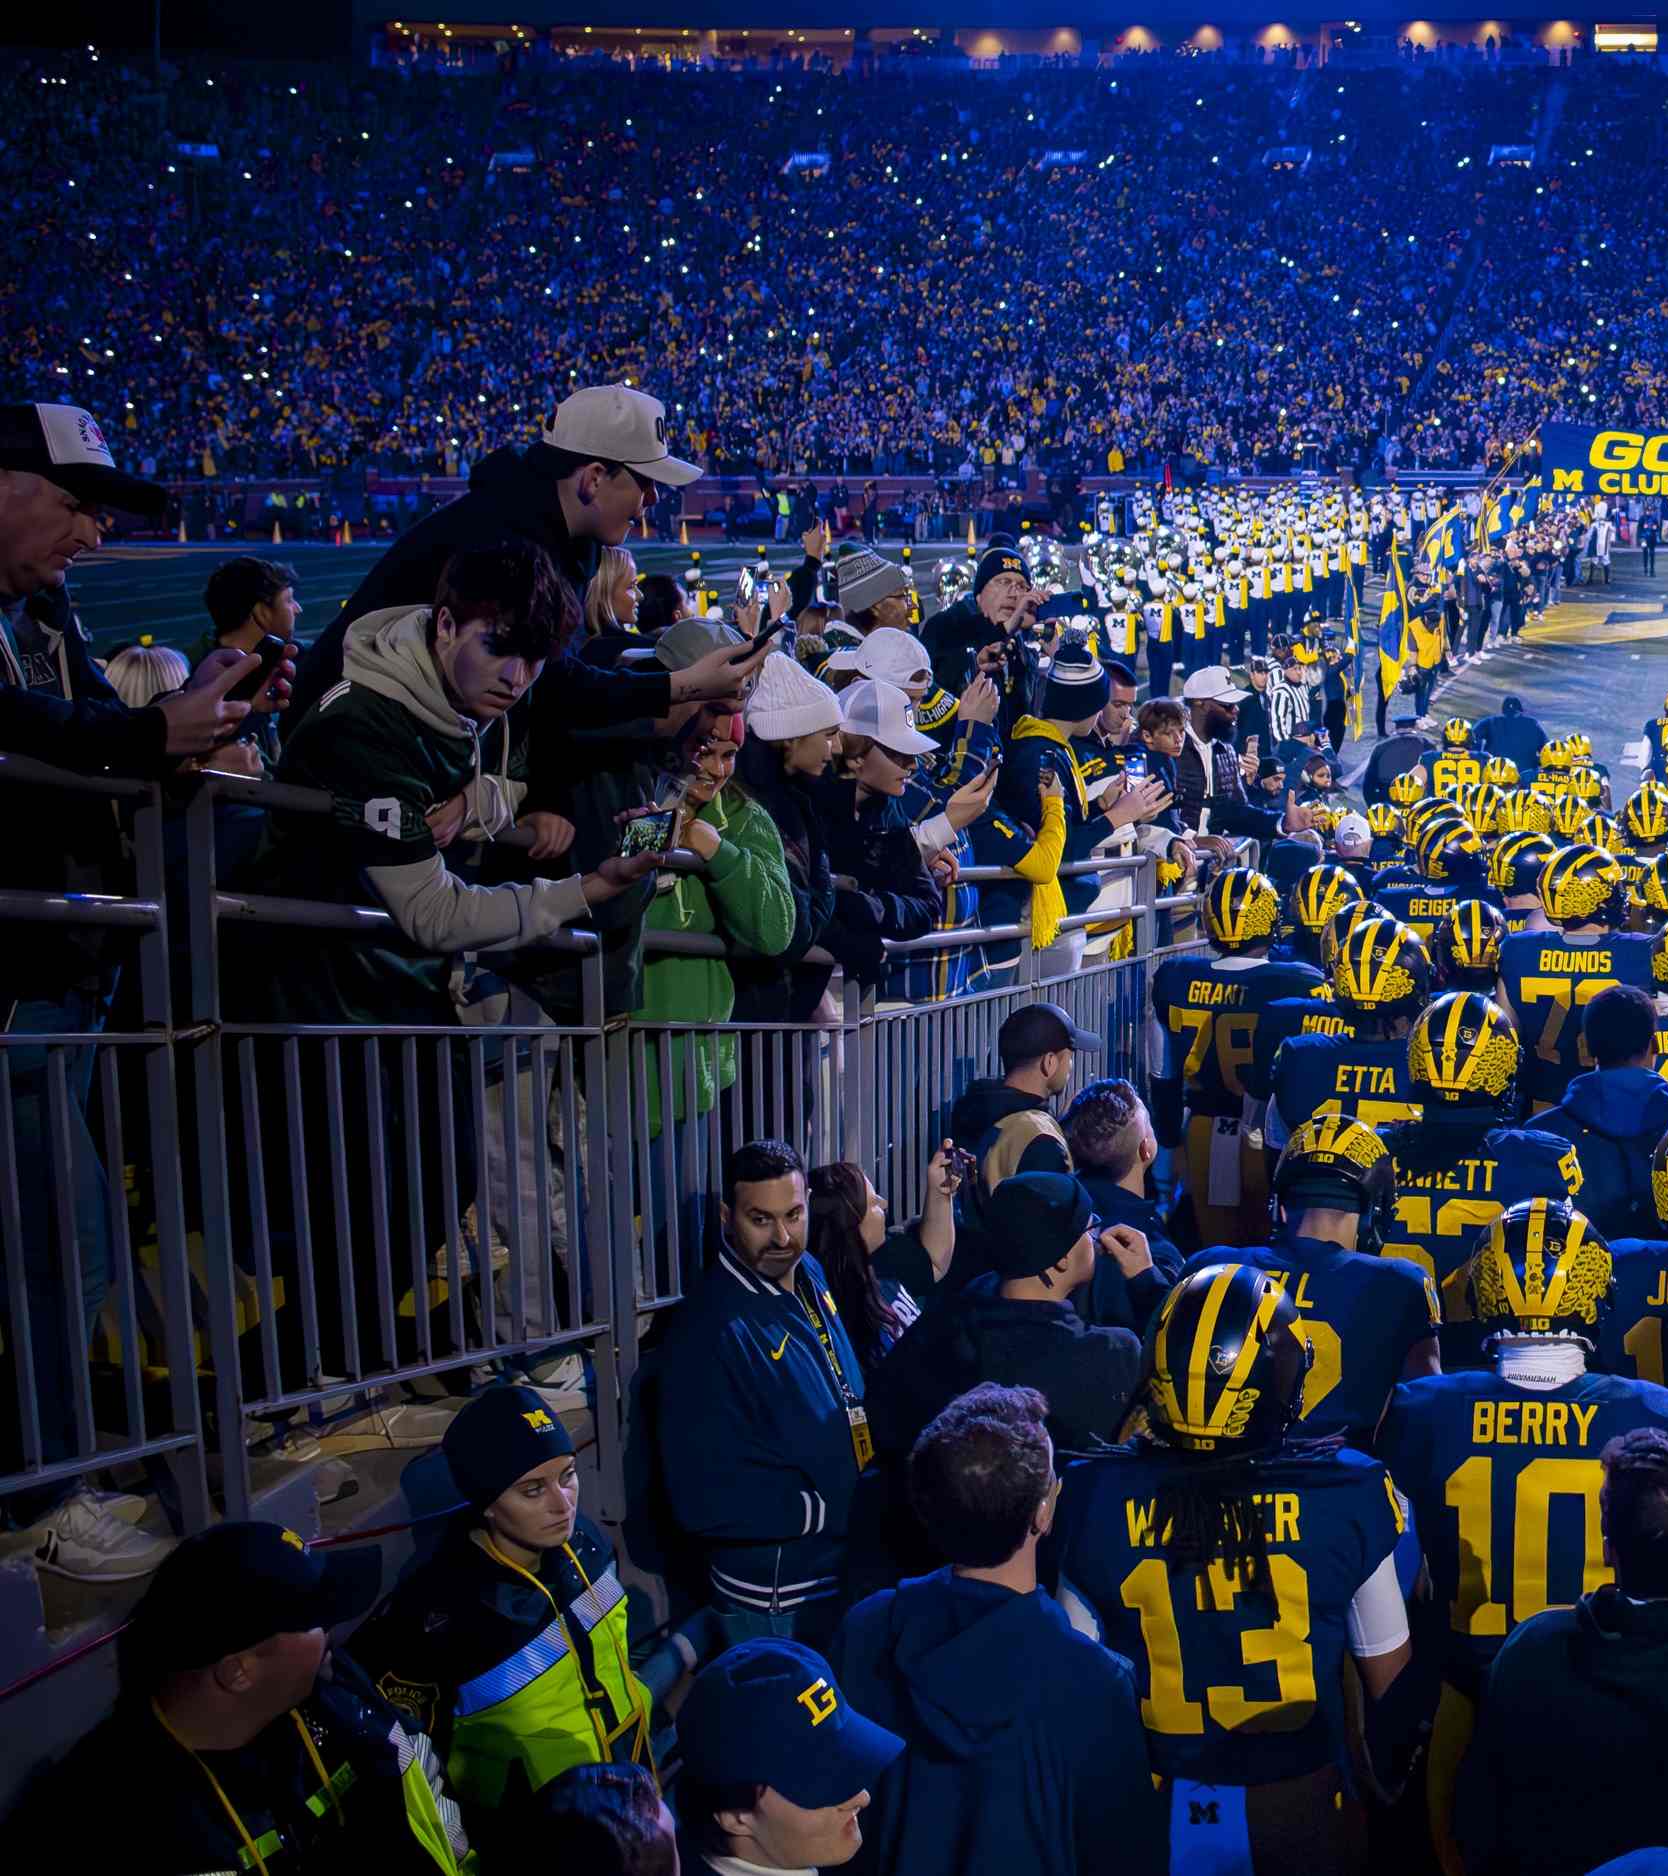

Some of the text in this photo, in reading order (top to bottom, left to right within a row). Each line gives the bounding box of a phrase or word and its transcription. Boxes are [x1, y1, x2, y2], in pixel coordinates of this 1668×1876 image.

[1551, 468, 1584, 493] M
[1433, 760, 1480, 798] 68
[1539, 949, 1612, 973] BOUNDS
[1187, 979, 1249, 1006] GRANT
[1335, 1064, 1396, 1095] ETTA
[1471, 1401, 1598, 1446] BERRY
[1445, 1456, 1615, 1636] 10
[1120, 1553, 1317, 1736] 13
[796, 1676, 839, 1728] G
